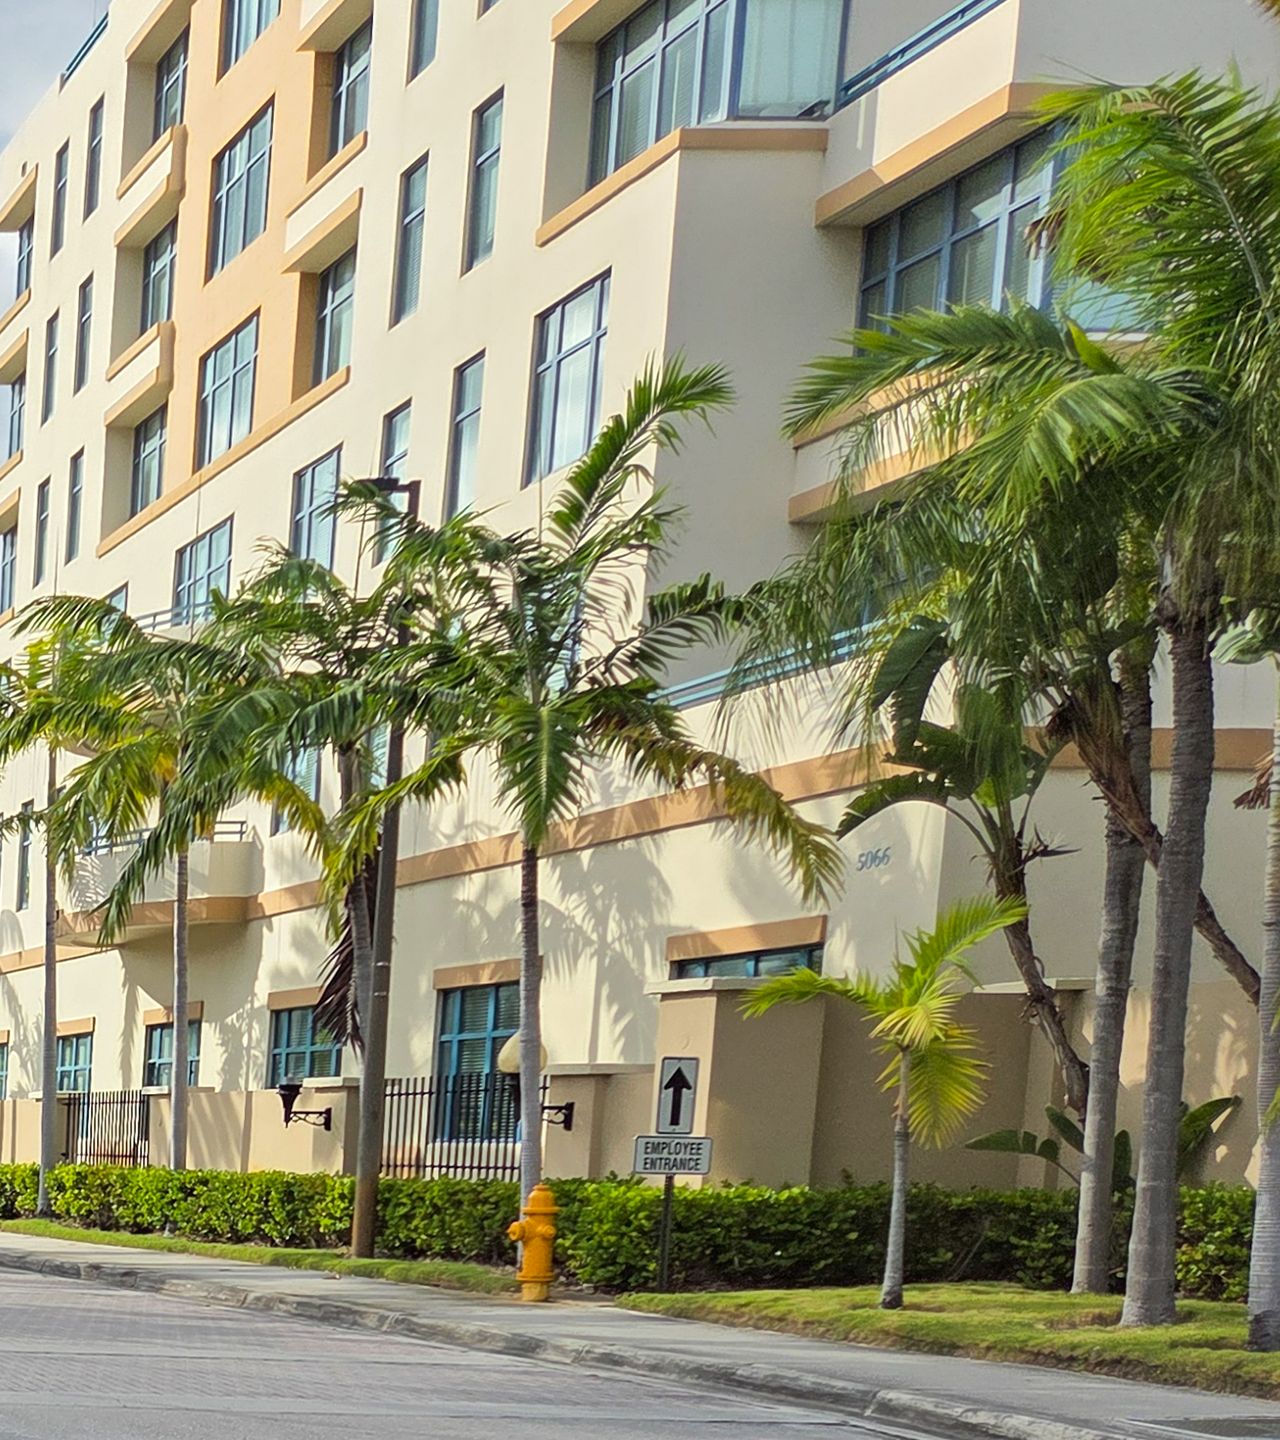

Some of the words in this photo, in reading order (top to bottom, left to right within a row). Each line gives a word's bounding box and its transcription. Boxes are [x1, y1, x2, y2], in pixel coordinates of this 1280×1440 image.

[856, 847, 891, 872] 5066
[643, 1141, 703, 1156] EMPLOYEE
[642, 1157, 702, 1171] ENTRANCE
